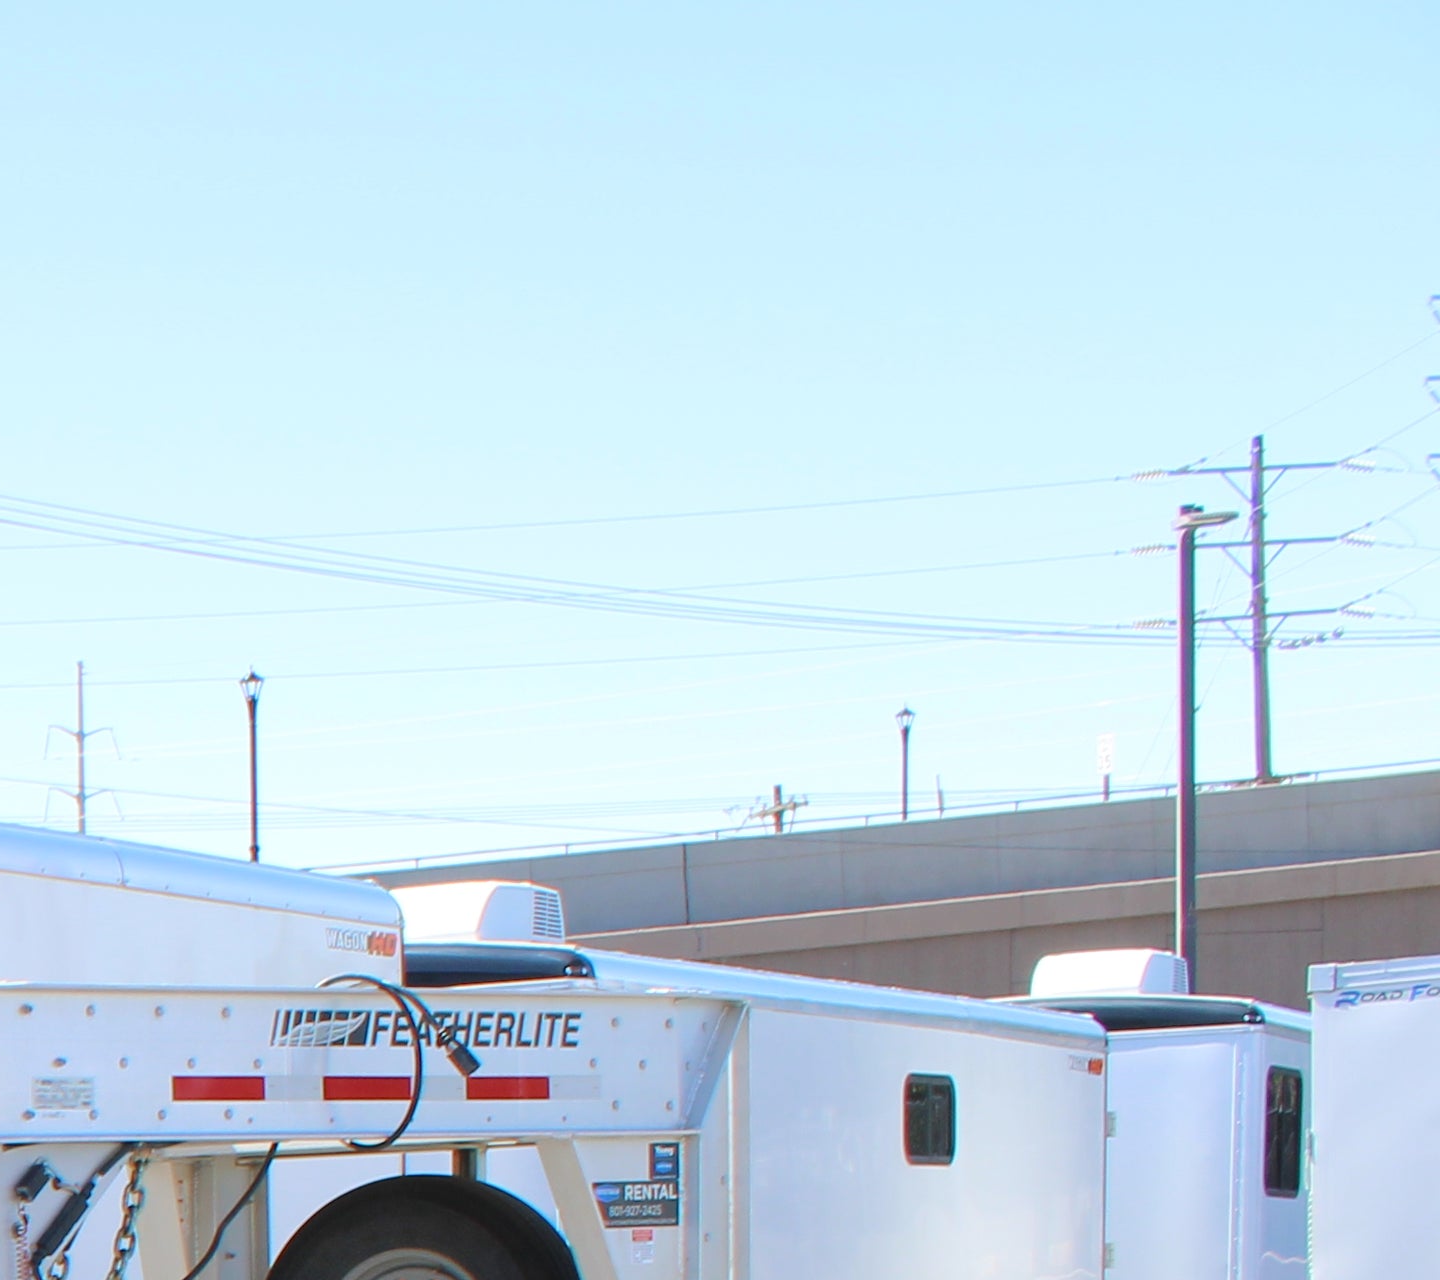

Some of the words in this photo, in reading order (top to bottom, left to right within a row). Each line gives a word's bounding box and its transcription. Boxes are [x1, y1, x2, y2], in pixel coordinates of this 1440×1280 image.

[325, 927, 368, 952] WAGON
[370, 1010, 582, 1047] FEATHERLITE
[624, 1183, 677, 1201] RENTAL
